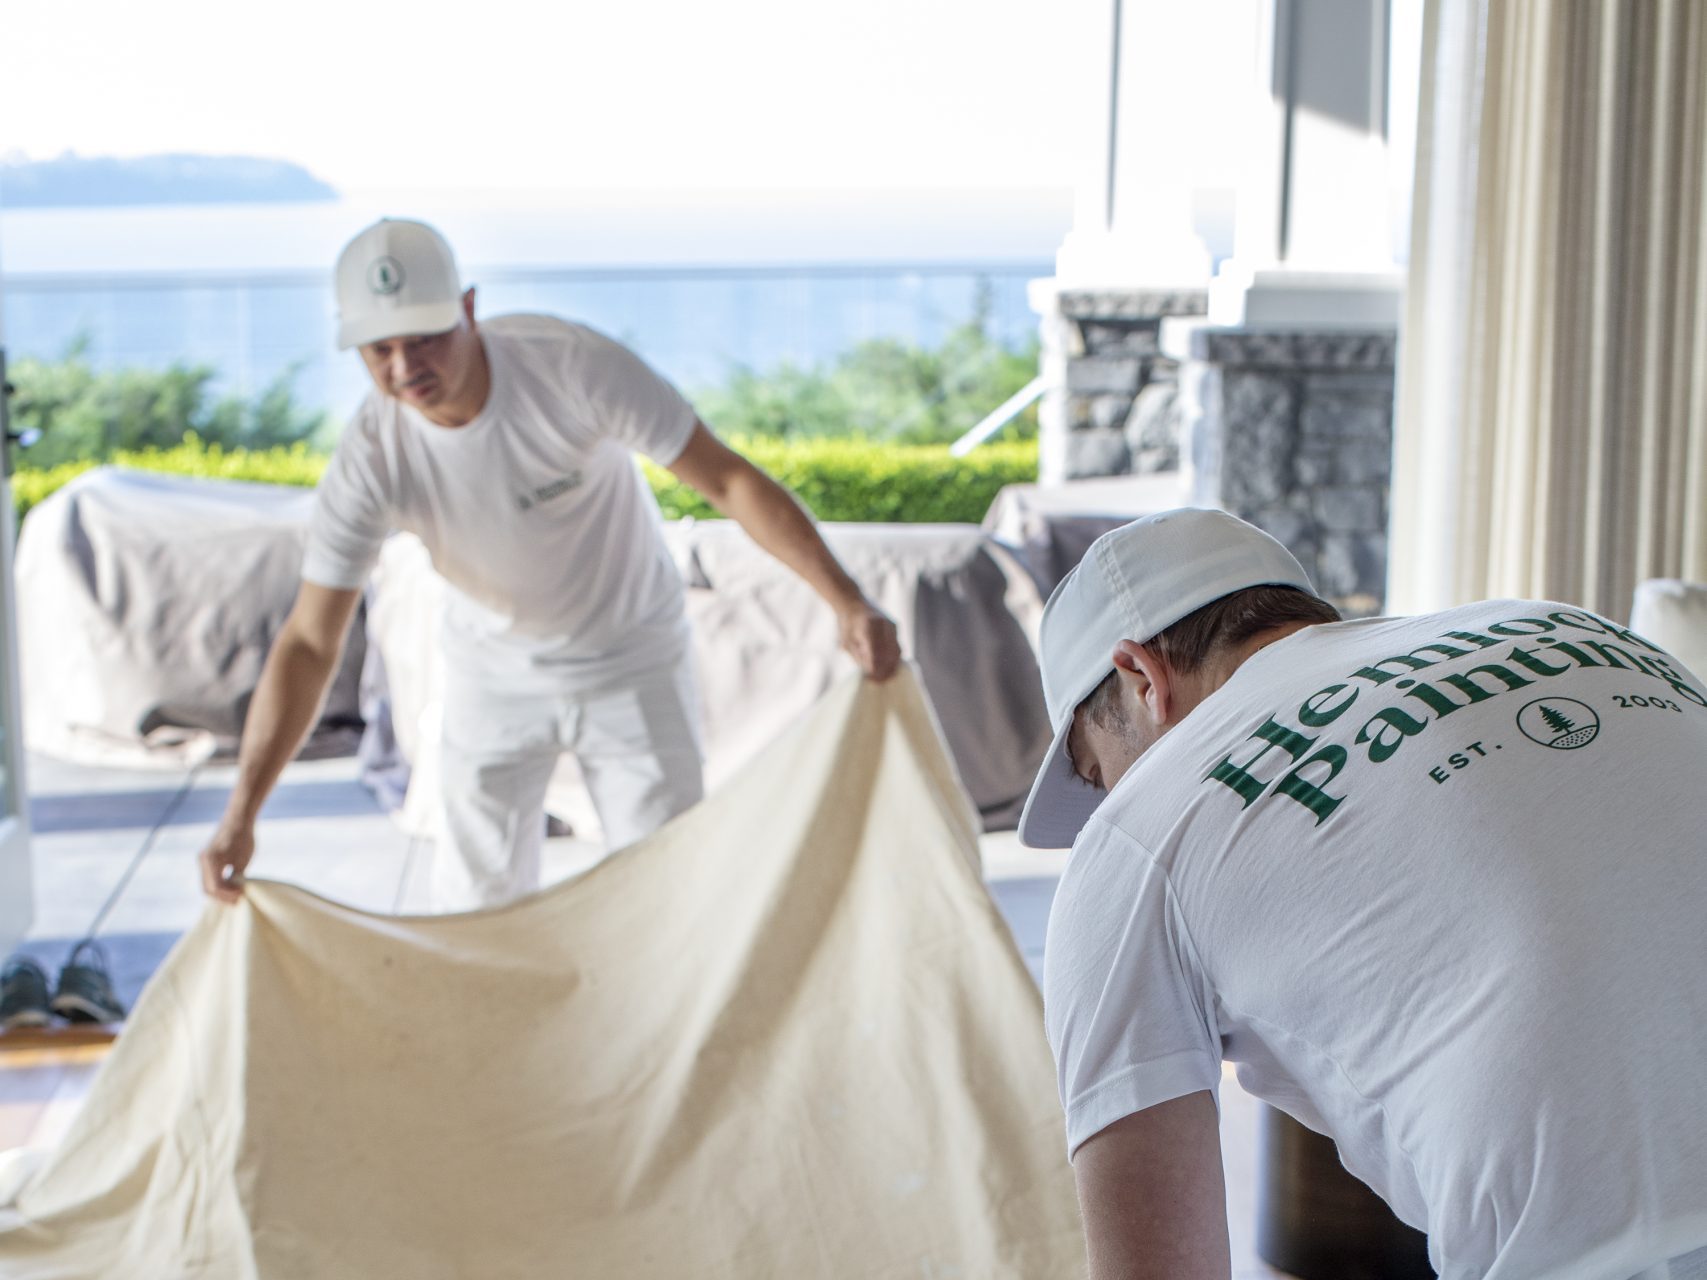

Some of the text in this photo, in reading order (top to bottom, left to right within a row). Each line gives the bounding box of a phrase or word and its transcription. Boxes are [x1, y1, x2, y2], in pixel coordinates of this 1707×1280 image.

[1270, 637, 1707, 827] Painting
[1428, 695, 1683, 785] EST. 2003
